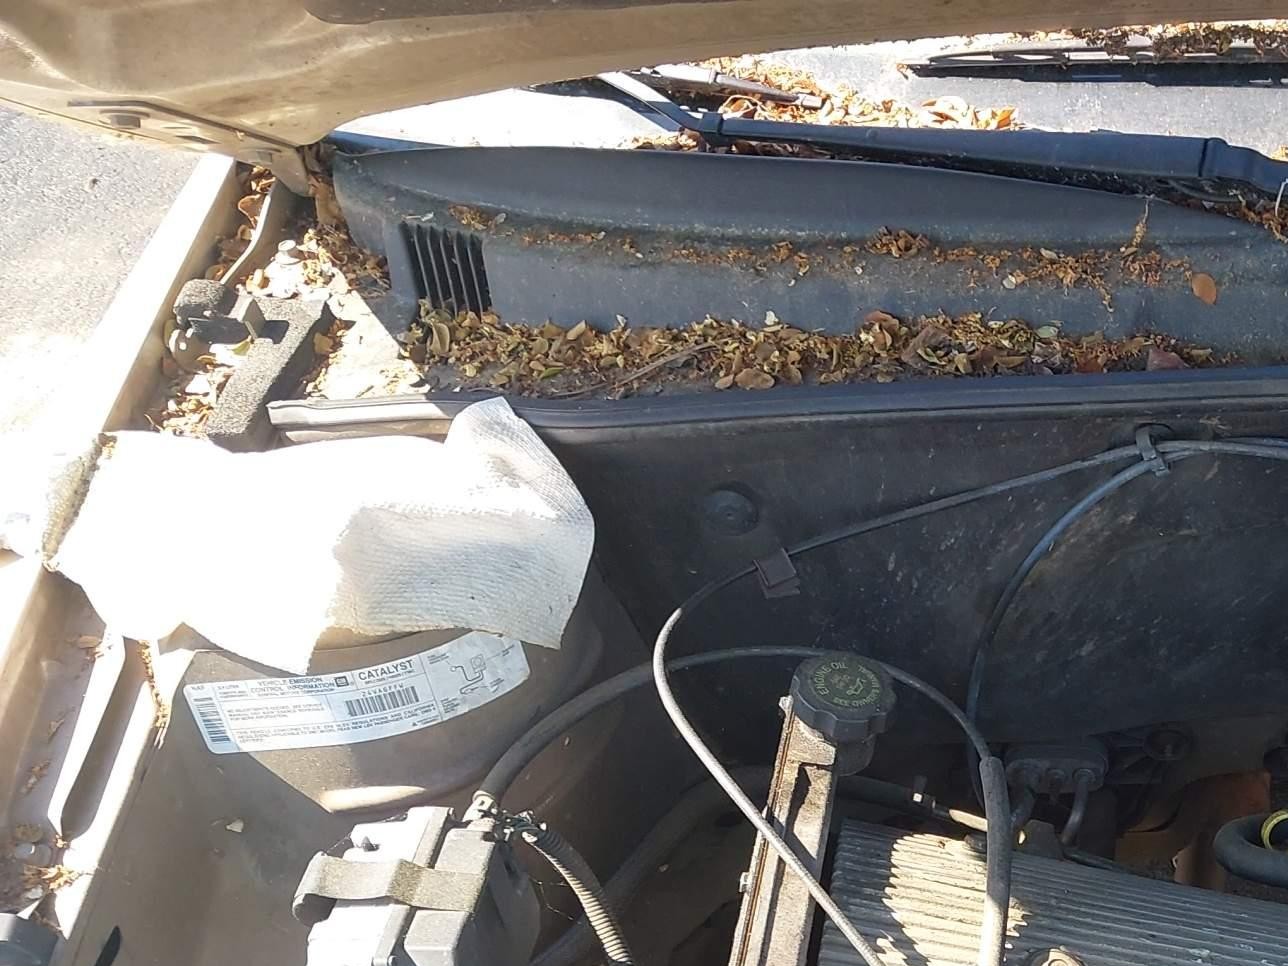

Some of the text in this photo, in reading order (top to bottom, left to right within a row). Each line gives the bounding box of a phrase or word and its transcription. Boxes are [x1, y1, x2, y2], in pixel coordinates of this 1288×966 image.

[358, 659, 414, 681] CATALYST
[258, 677, 323, 687] VEHICLE EMISSION
[287, 682, 335, 691] INFORMATION
